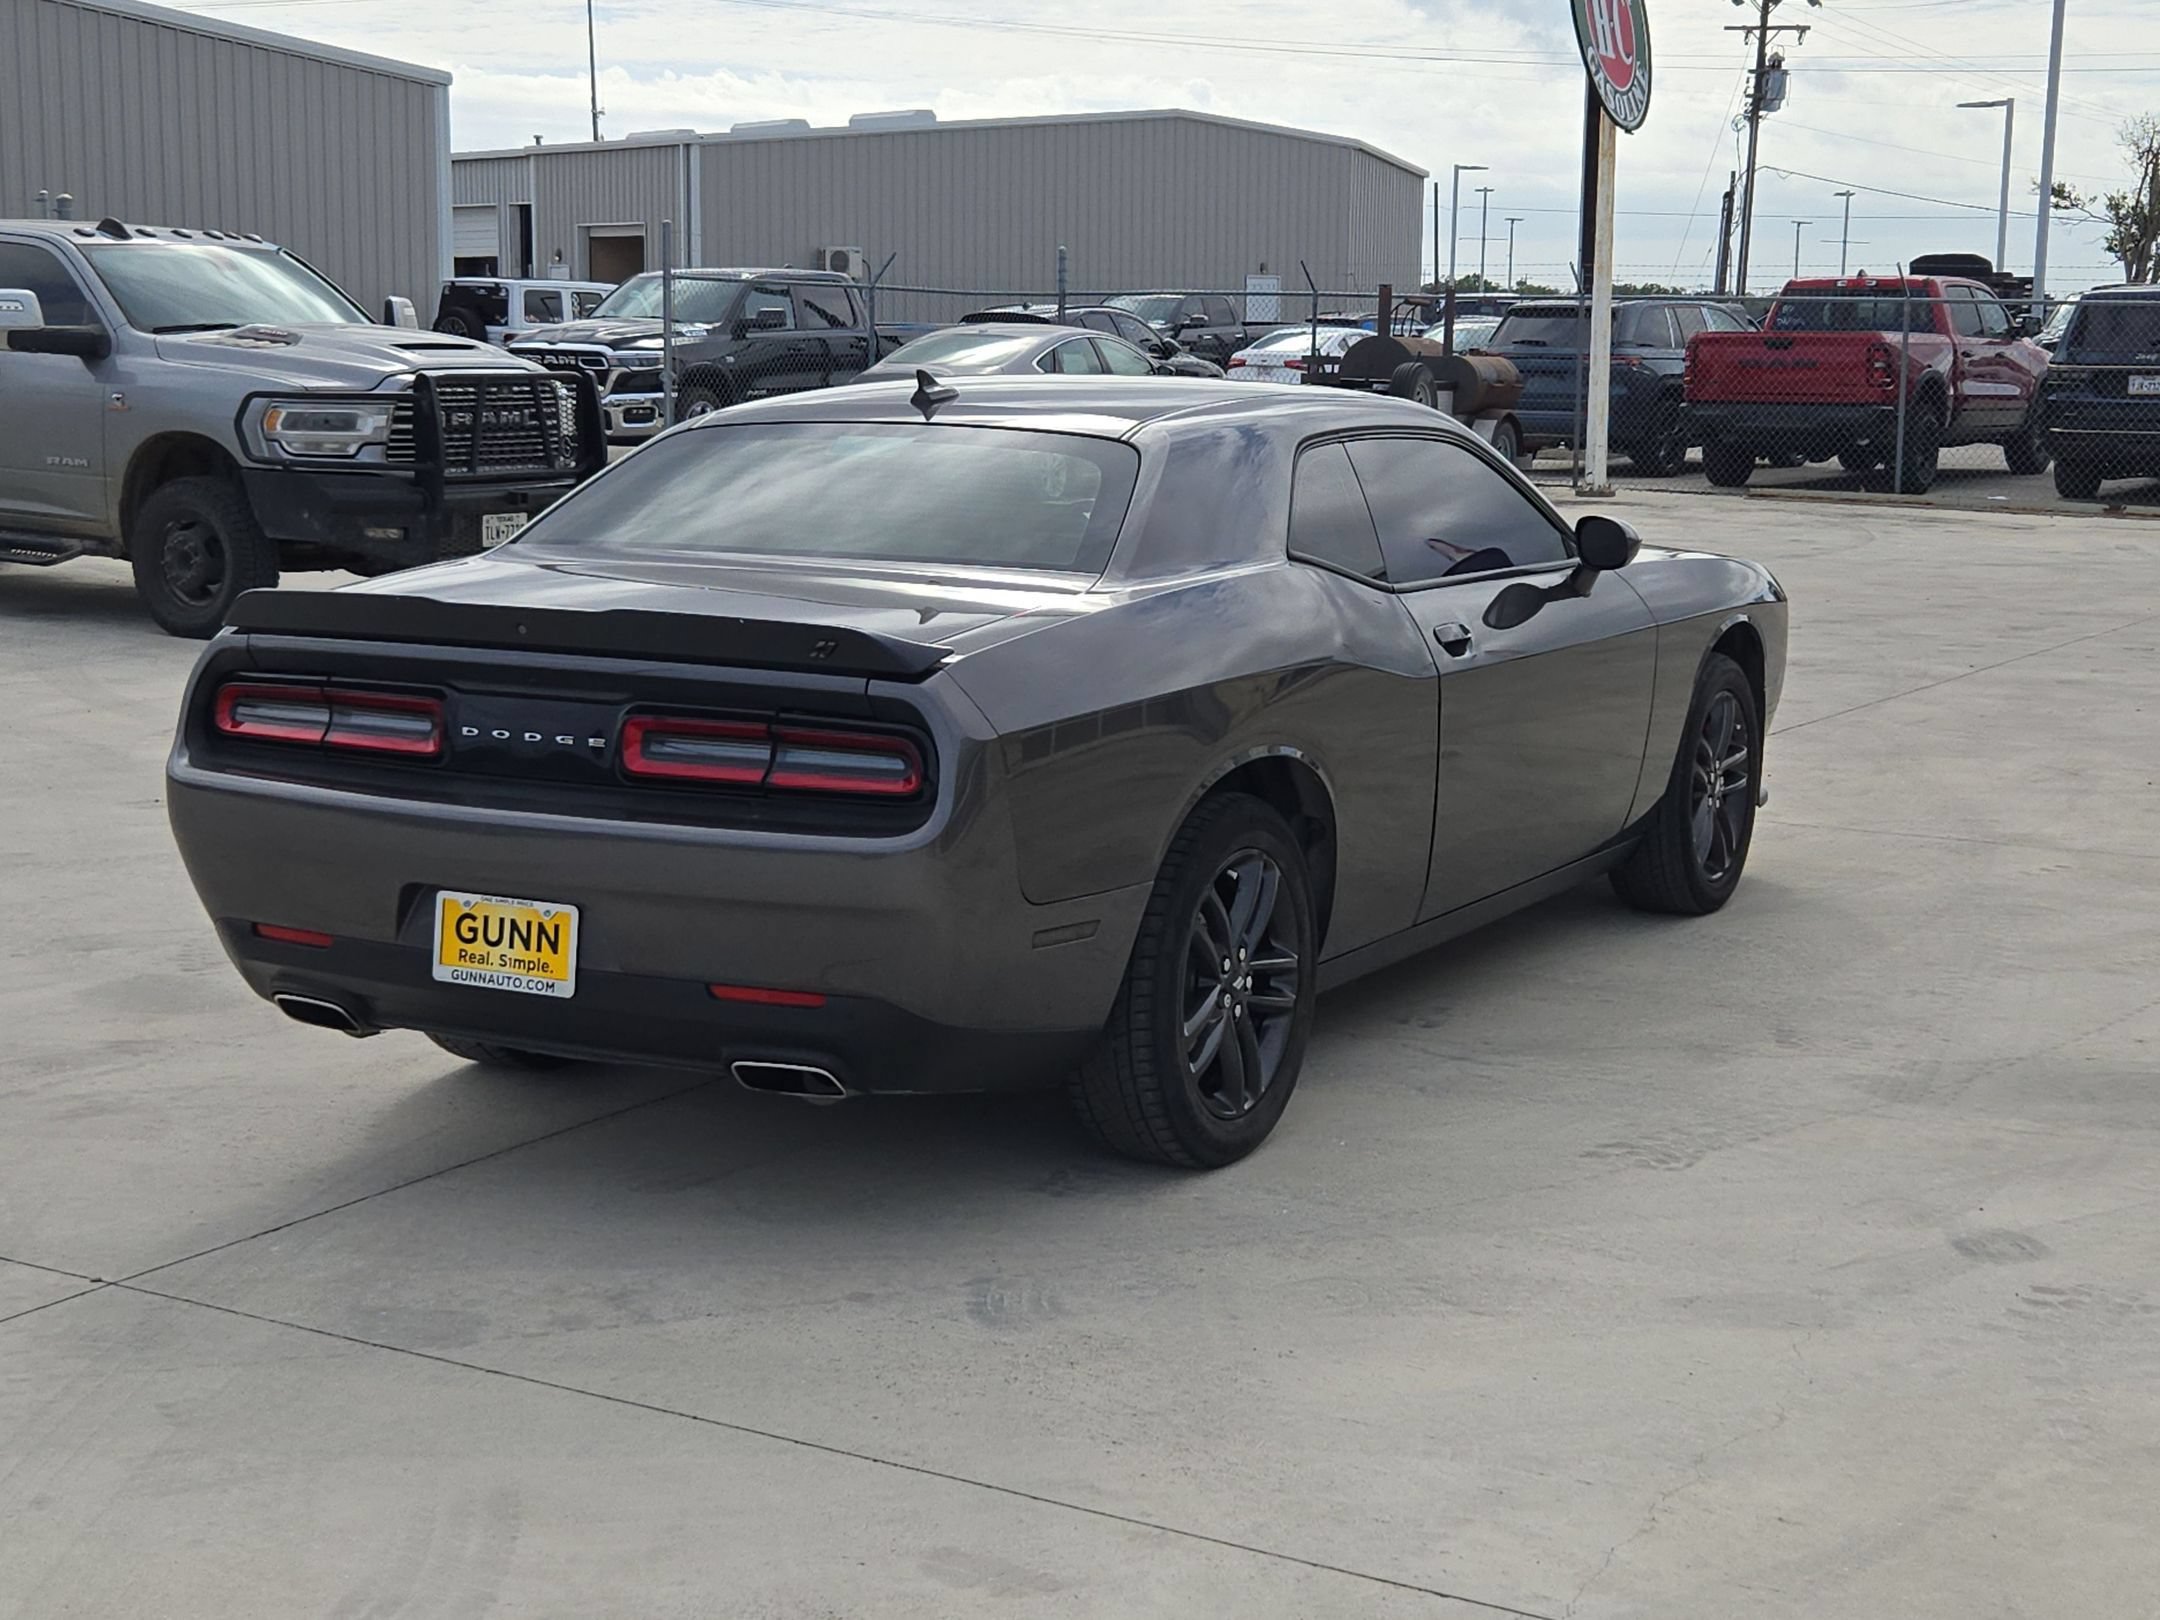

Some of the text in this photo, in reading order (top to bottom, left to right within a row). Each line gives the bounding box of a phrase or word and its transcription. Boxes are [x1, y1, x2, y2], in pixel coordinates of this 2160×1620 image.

[46, 456, 89, 468] RAM
[461, 726, 606, 748] DODGE
[455, 912, 560, 955] GUNN
[458, 948, 494, 967] Real.
[451, 968, 556, 993] GUNNAUTO.COM
